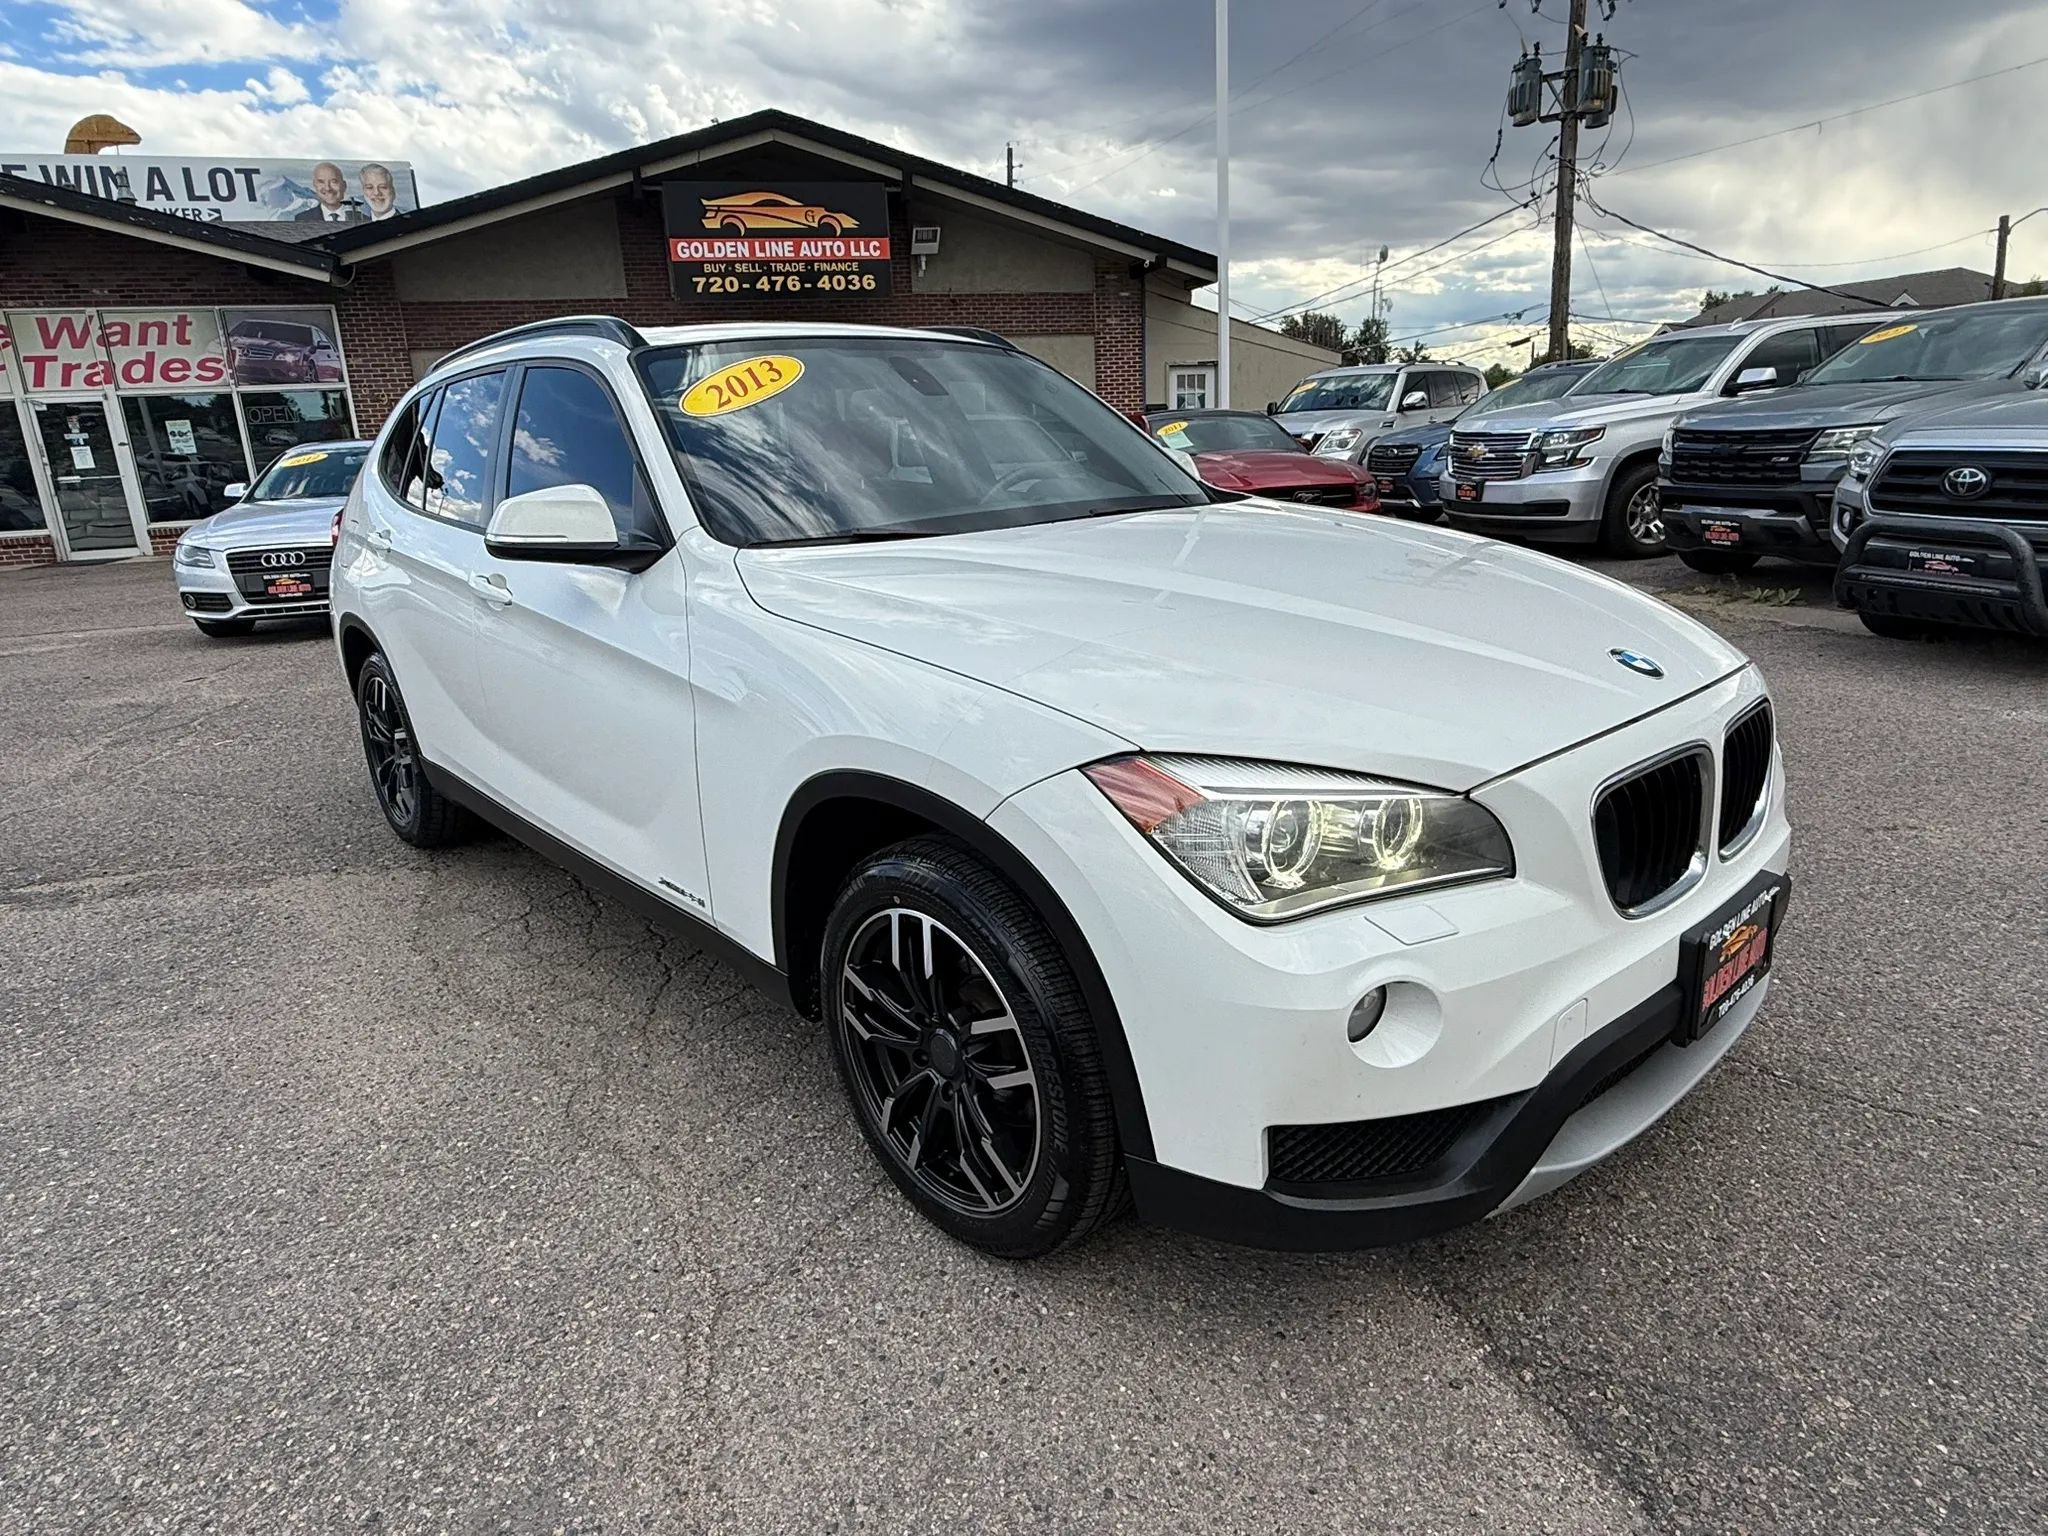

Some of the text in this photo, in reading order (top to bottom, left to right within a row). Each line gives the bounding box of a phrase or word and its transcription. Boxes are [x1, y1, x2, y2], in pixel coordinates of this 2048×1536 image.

[38, 164, 261, 202] WIN A LOT
[677, 240, 881, 259] GOLDEN LINE AUTO LLC
[703, 261, 860, 273] BUY SELL TRADE FINANCE
[691, 274, 876, 293] 720-476-4036
[35, 314, 193, 350] Want
[705, 359, 783, 409] 2013
[248, 408, 297, 423] OPEN
